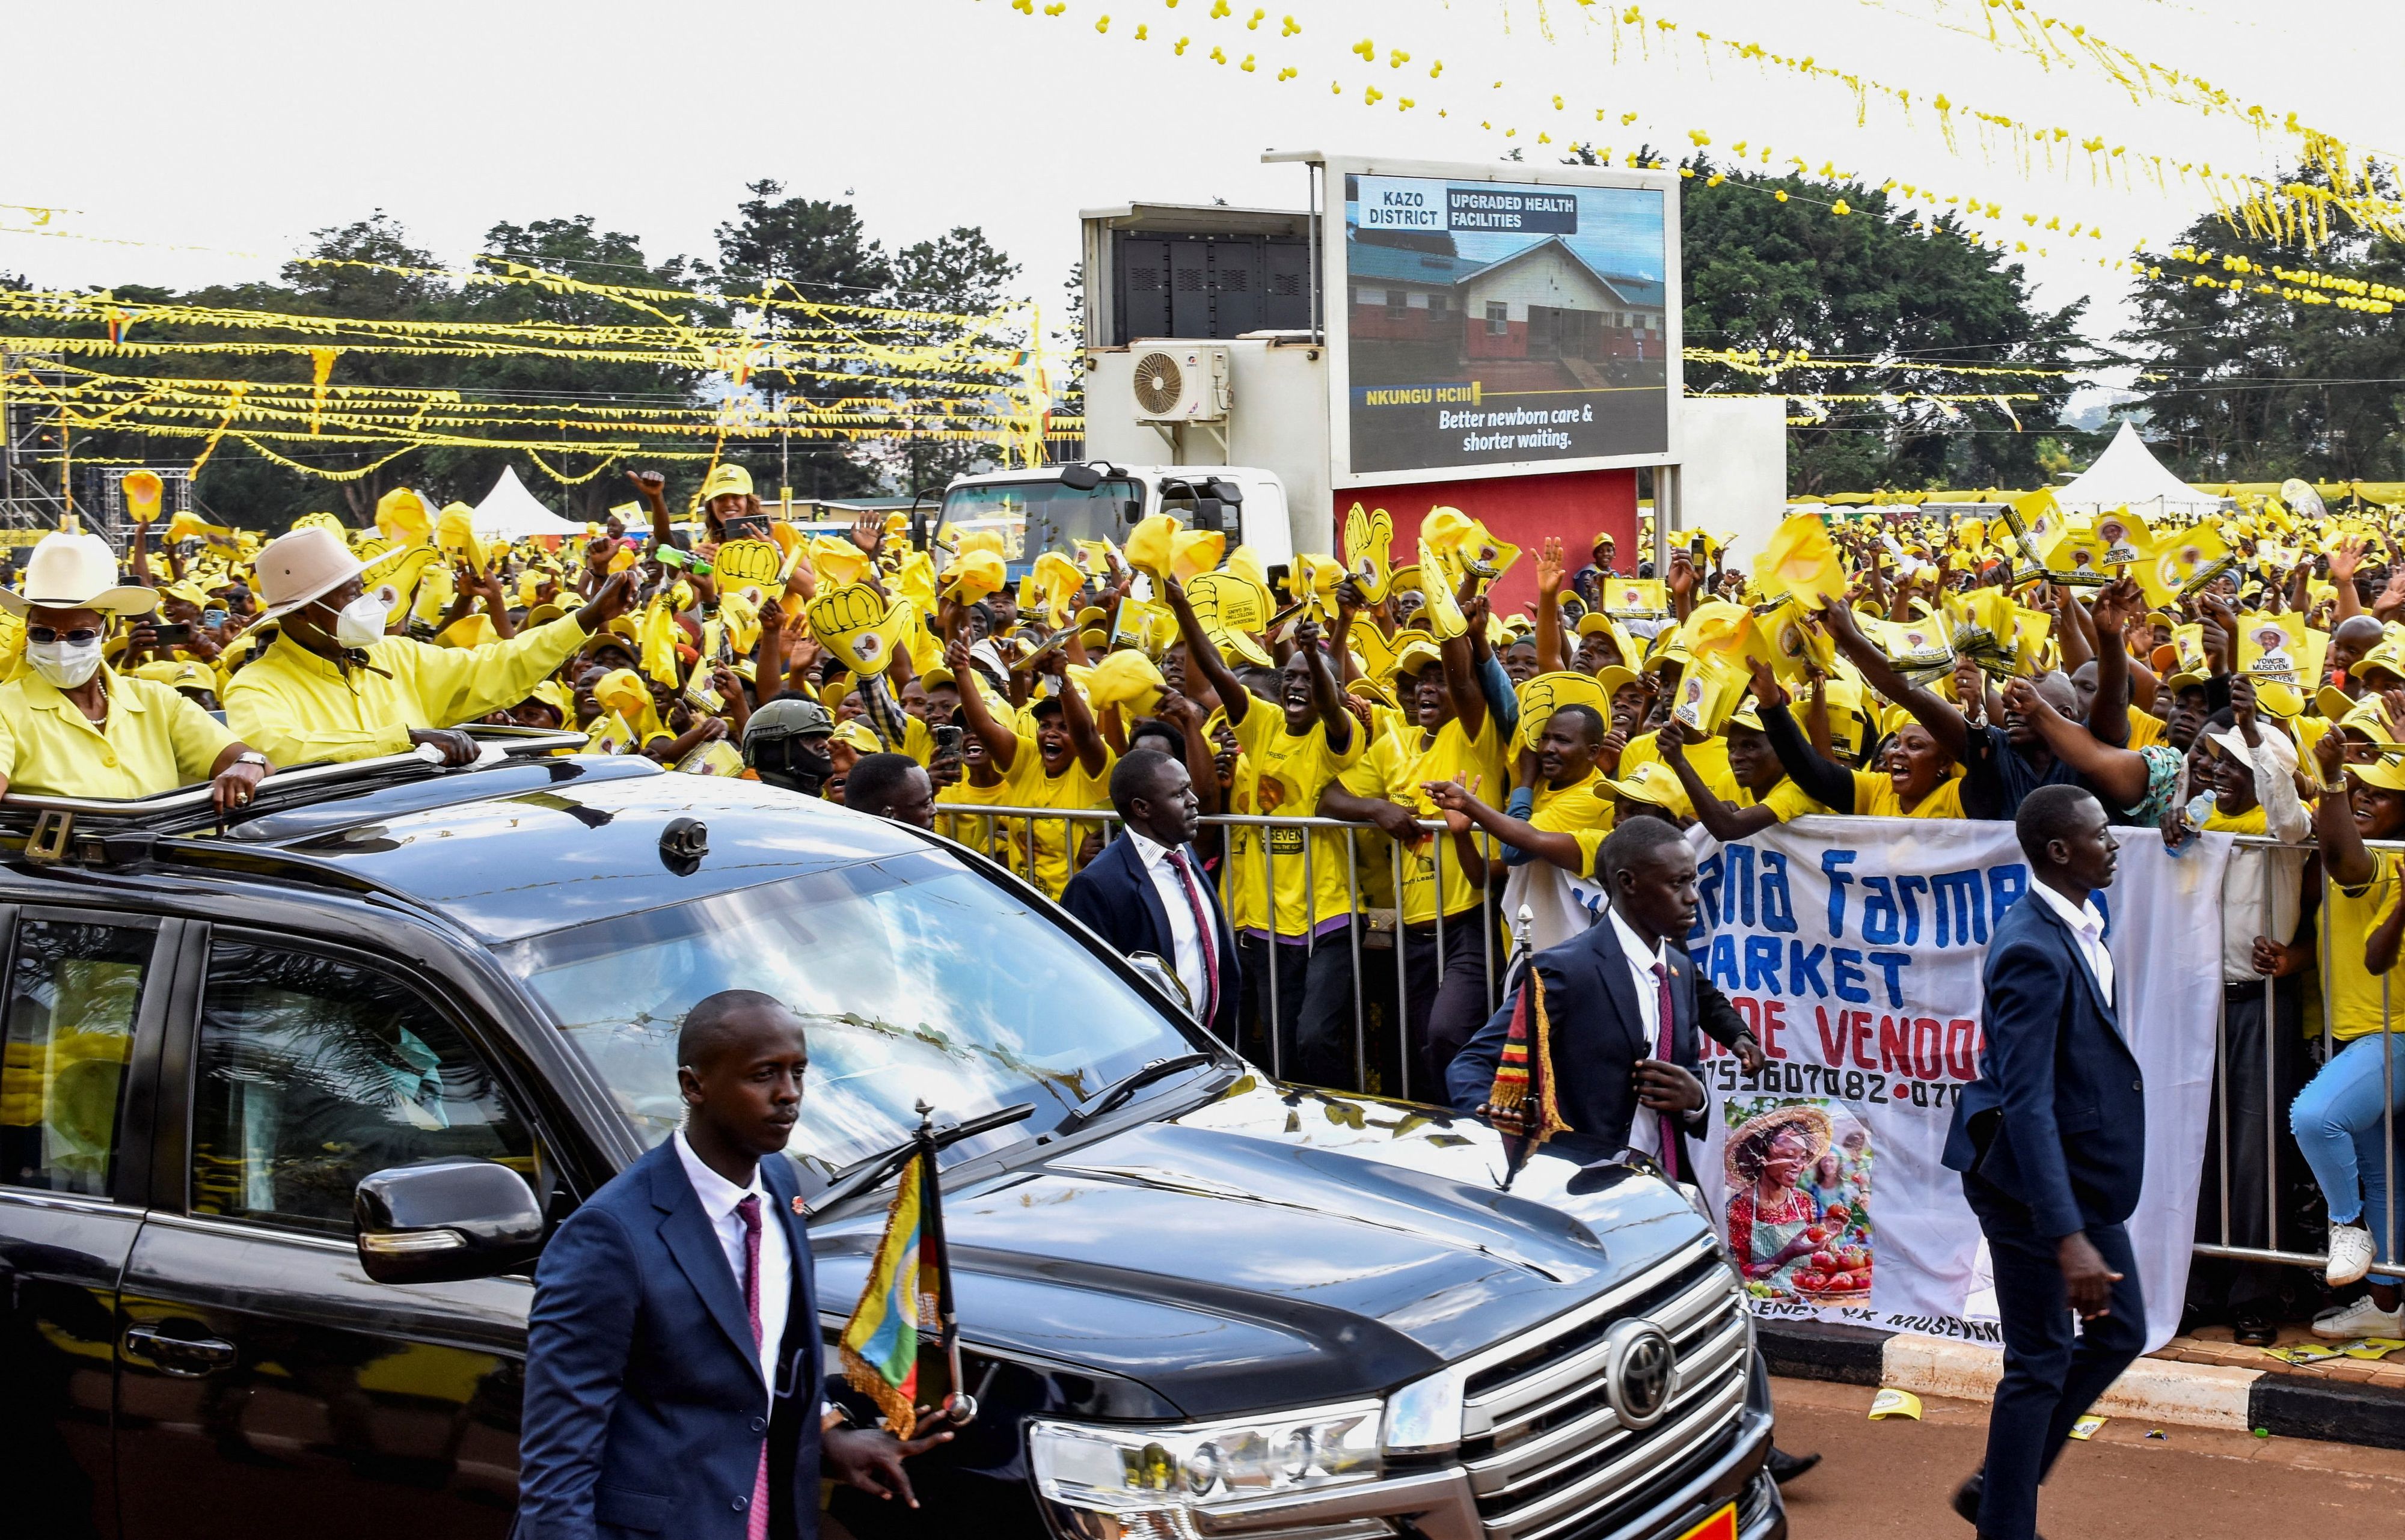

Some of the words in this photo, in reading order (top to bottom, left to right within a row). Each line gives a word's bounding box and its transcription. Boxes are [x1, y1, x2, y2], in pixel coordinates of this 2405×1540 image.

[1383, 191, 1423, 207] KAZO
[1450, 194, 1522, 210] UPGRADED
[1525, 198, 1574, 213] HEALTH
[1370, 209, 1438, 225] DISTRICT
[1451, 212, 1522, 228] FACILITIES
[1366, 388, 1432, 406] NKUNGU
[1436, 387, 1472, 403] HCIII
[1439, 410, 1485, 429] Better
[1487, 406, 1548, 426] newborn
[1551, 409, 1579, 423] care
[1582, 404, 1593, 422] &
[1463, 432, 1515, 451] shorter
[1517, 428, 1572, 450] waiting.
[1417, 873, 1435, 882] Lead
[1816, 1004, 1985, 1081] VENDO
[1886, 1313, 2001, 1343] MUSEVEN
